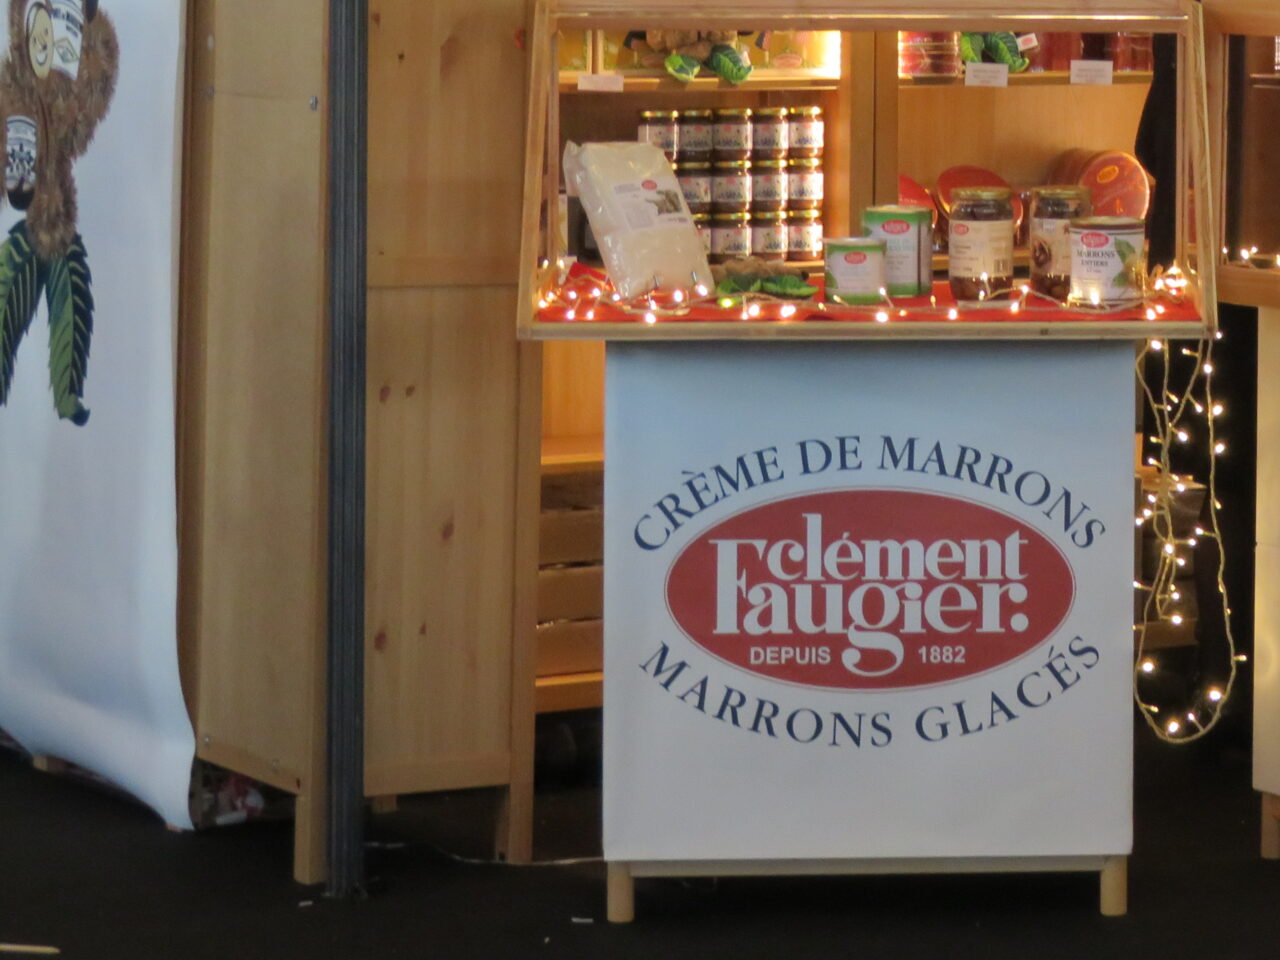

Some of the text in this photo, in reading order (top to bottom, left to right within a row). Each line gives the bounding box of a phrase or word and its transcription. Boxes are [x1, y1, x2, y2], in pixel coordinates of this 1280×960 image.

[633, 434, 1107, 553] CRÈME DE MARRONS
[766, 512, 1029, 581] clément
[638, 634, 1103, 748] MARRONS GLACÉS
[750, 645, 966, 666] DEPUIS 1882
